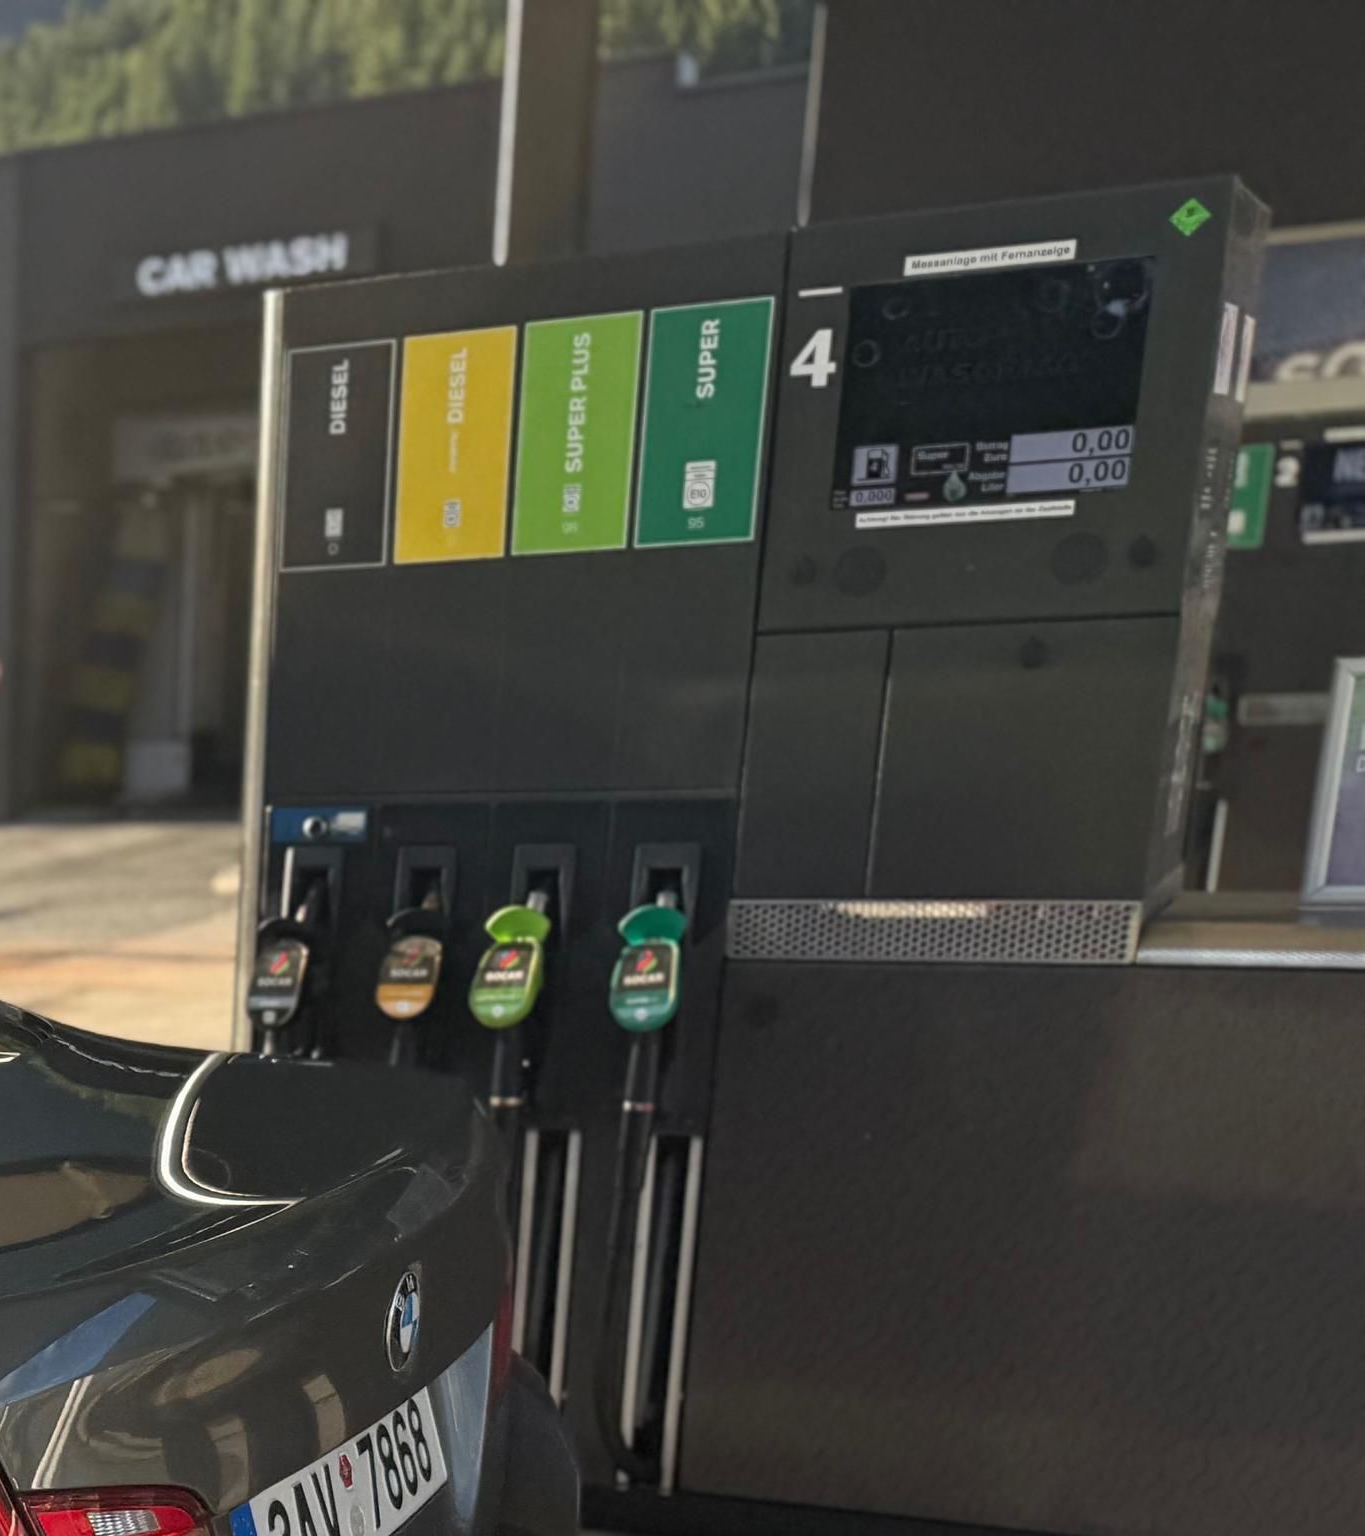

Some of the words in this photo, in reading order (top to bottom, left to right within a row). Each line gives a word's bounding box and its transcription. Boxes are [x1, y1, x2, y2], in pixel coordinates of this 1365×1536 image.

[135, 249, 218, 296] CAR
[223, 232, 348, 284] WASH
[911, 255, 978, 270] Messanlage
[979, 252, 999, 264] mit
[1001, 245, 1071, 261] Fernanzeige
[446, 347, 469, 424] DIESEL
[570, 332, 592, 392] PLUS
[696, 318, 721, 399] SUPER
[789, 328, 837, 388] 4
[329, 358, 350, 435] DIESEL
[565, 396, 587, 473] SUPER
[1071, 428, 1131, 457] 0,00
[690, 489, 707, 499] E10
[1068, 459, 1127, 487] 0,00
[355, 1398, 433, 1533] 7868
